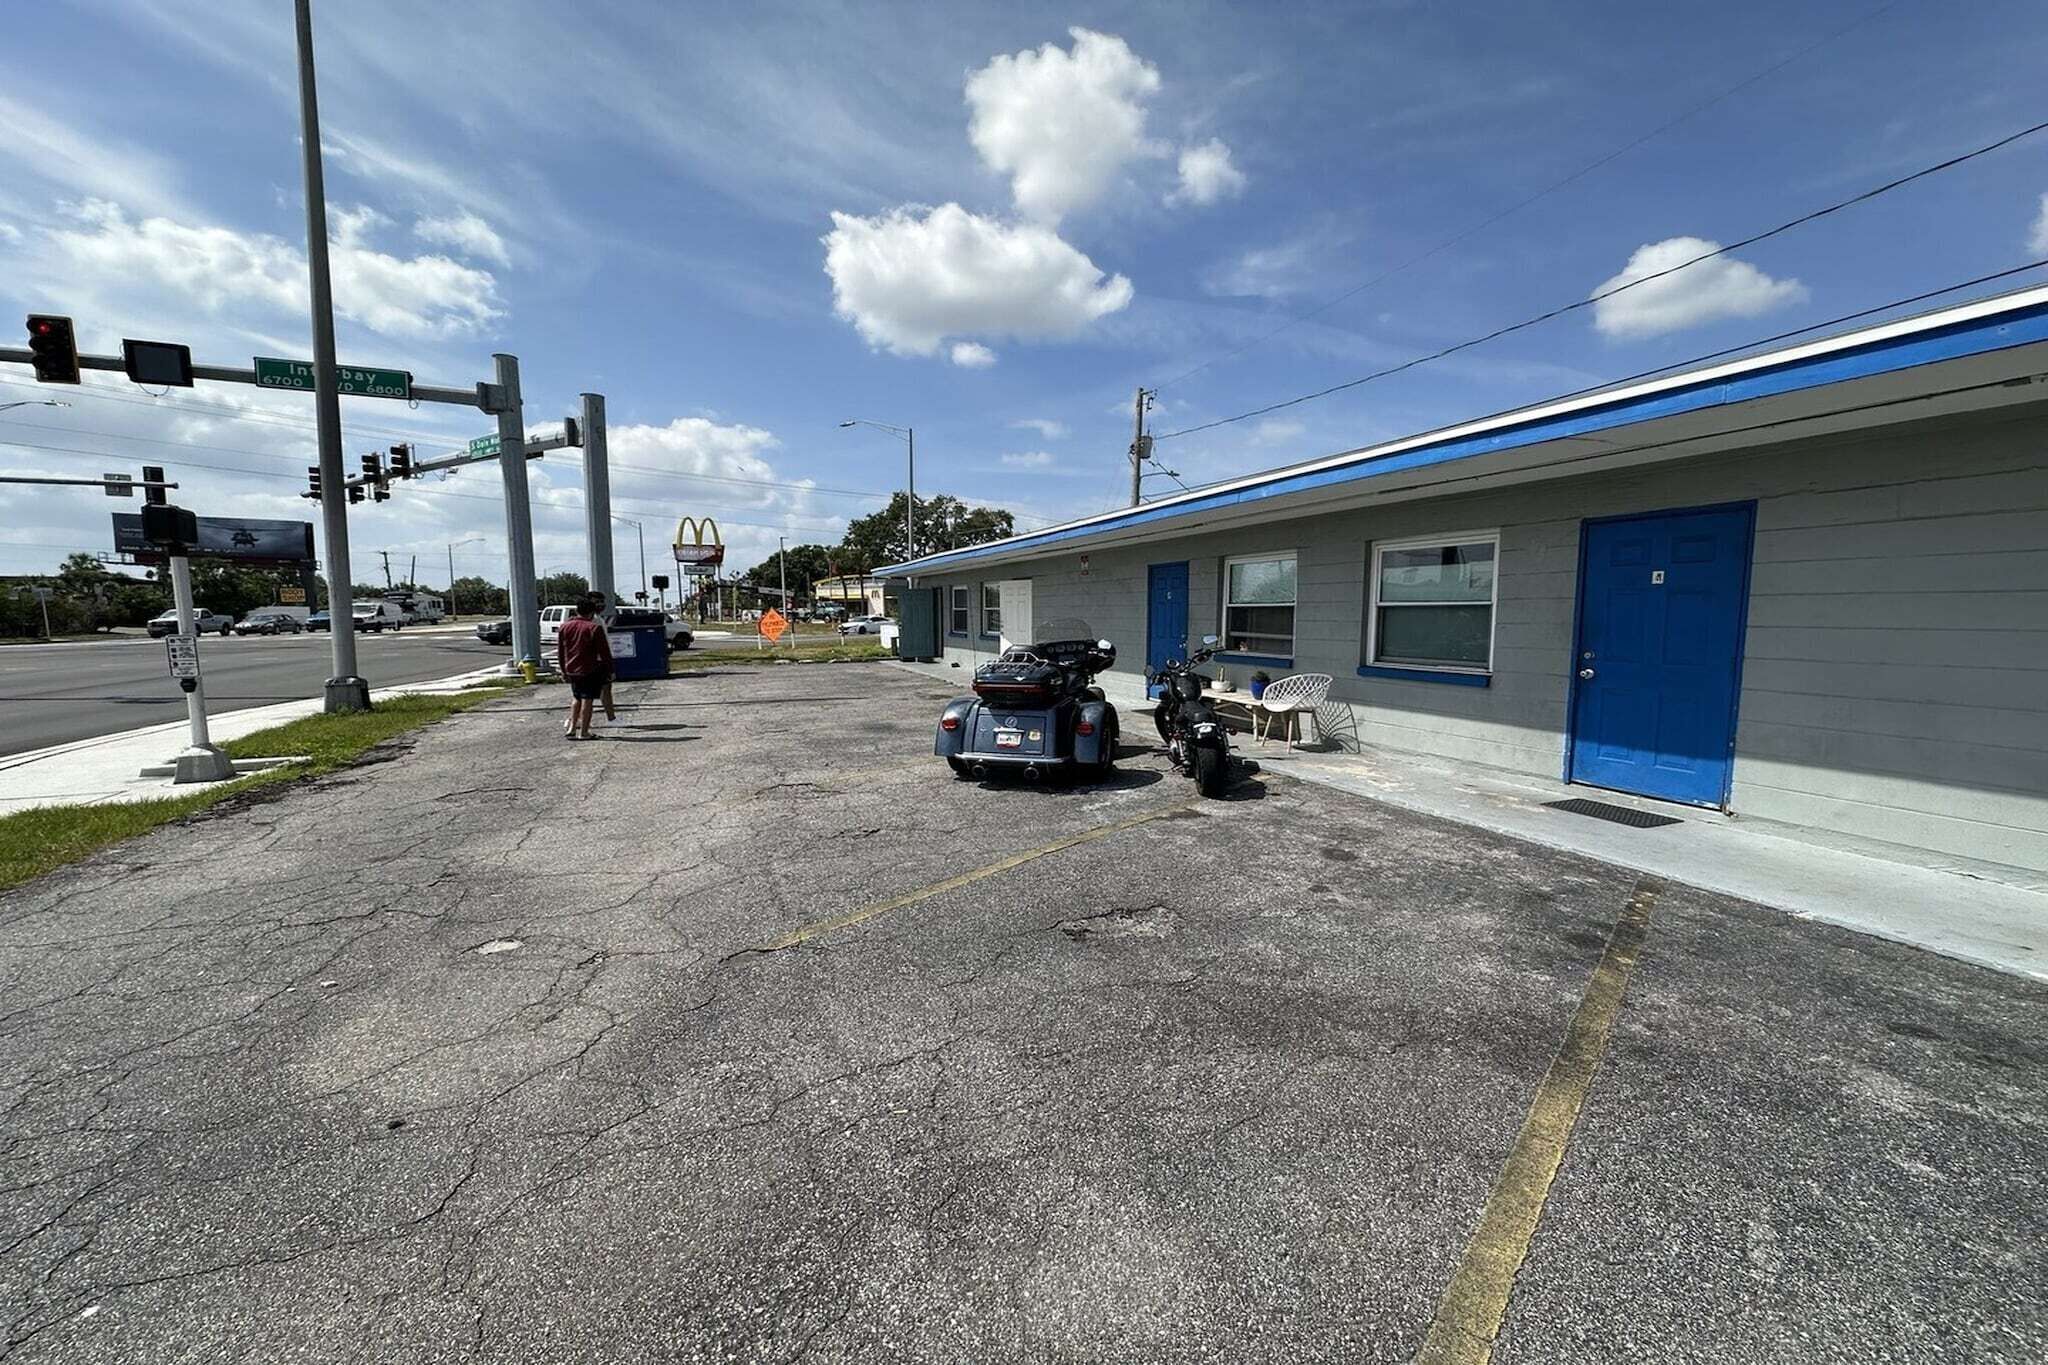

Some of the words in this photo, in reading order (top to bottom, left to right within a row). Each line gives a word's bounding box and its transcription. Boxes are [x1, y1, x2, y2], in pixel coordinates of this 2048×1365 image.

[289, 363, 377, 384] Intbay
[263, 374, 304, 387] 6700
[366, 384, 404, 396] 6800
